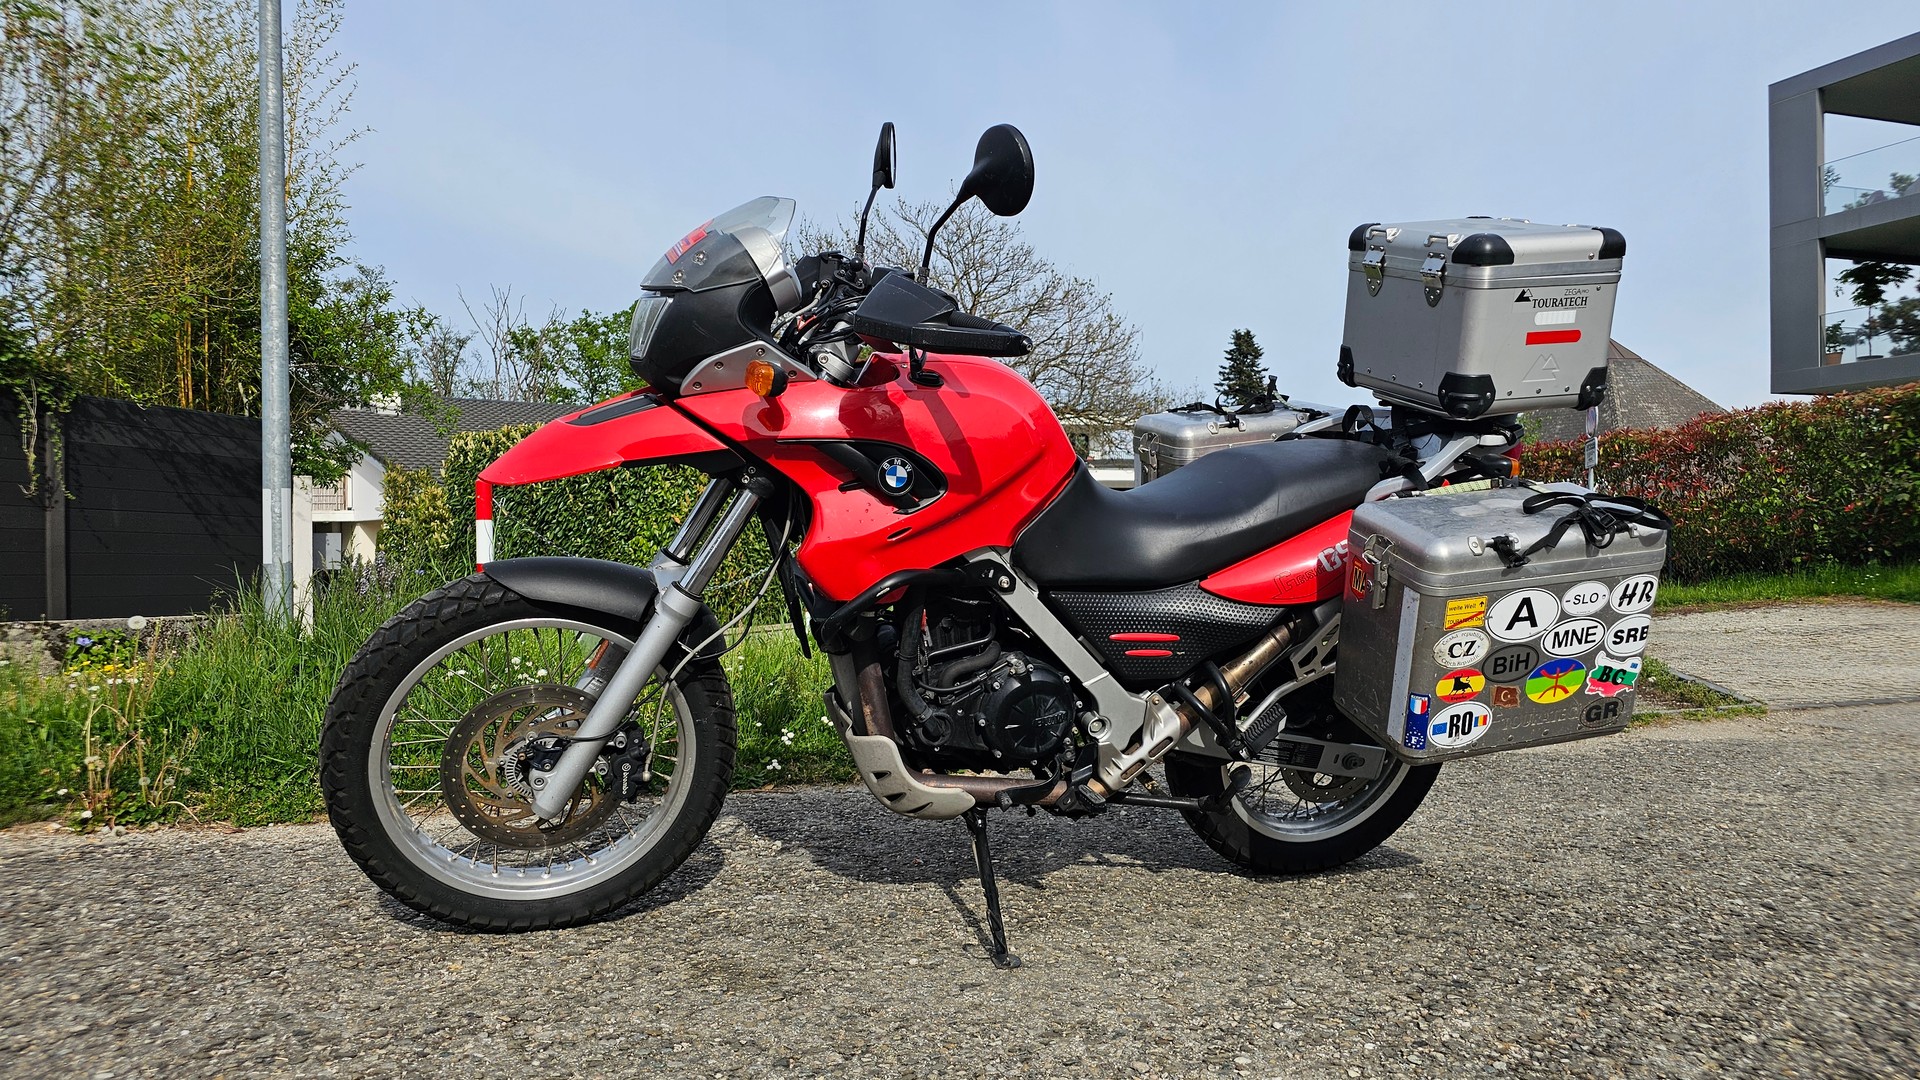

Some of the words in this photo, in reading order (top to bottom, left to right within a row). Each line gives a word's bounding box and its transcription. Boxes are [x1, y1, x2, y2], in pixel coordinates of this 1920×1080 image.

[1531, 296, 1588, 309] TOURATECH
[1564, 288, 1581, 296] ZEGA
[882, 458, 912, 472] BMW
[1617, 580, 1654, 608] HR
[1504, 596, 1538, 631] A
[1551, 625, 1598, 650] MNE
[1611, 624, 1650, 646] SRB
[1447, 639, 1478, 659] CZ
[1492, 652, 1531, 676] BiH
[1597, 665, 1628, 686] BG
[1585, 700, 1619, 723] GR
[1447, 710, 1474, 740] RO
[1411, 736, 1419, 745] F
